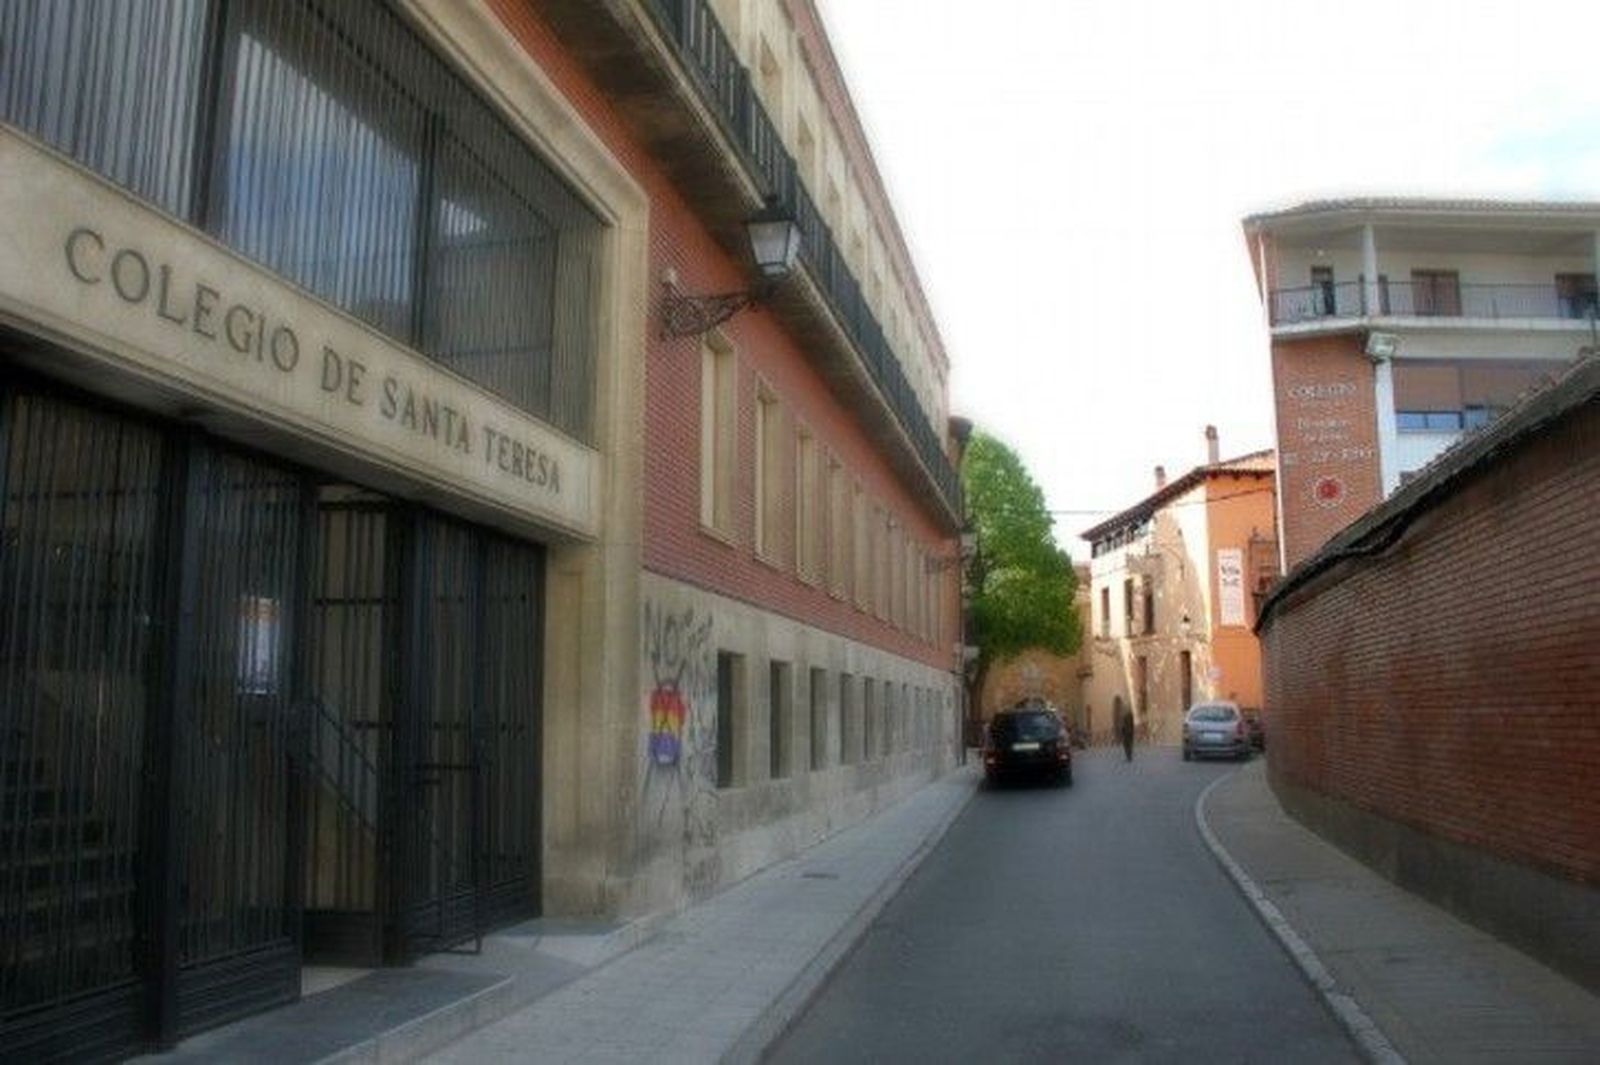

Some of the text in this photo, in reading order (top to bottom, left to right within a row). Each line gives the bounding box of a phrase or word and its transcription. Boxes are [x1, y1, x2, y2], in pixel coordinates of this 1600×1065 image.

[65, 228, 561, 494] COLEGIO DE SANTA TERESA
